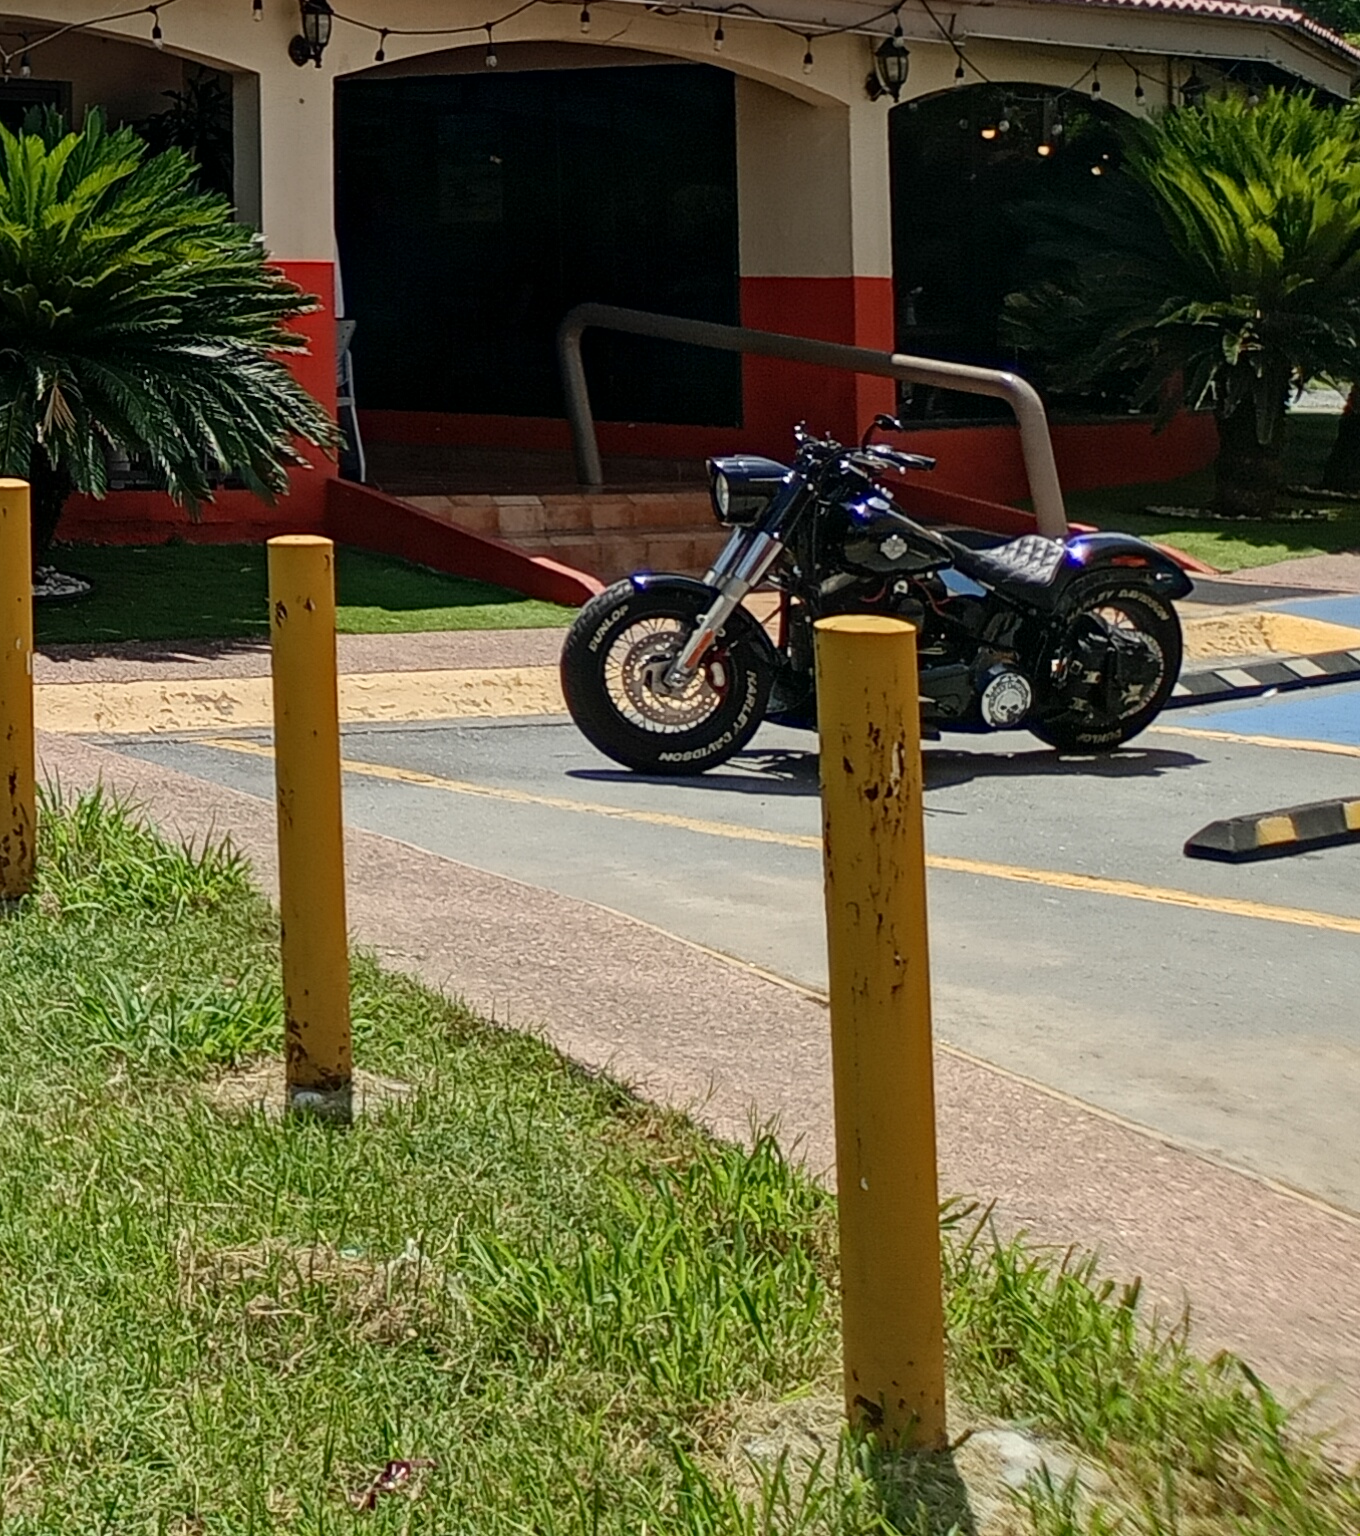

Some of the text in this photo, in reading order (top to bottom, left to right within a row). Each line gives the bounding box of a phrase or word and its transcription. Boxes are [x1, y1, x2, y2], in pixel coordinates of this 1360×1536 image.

[587, 604, 630, 652] DUNLOP
[658, 669, 758, 762] HARLEY DAVIDSON
